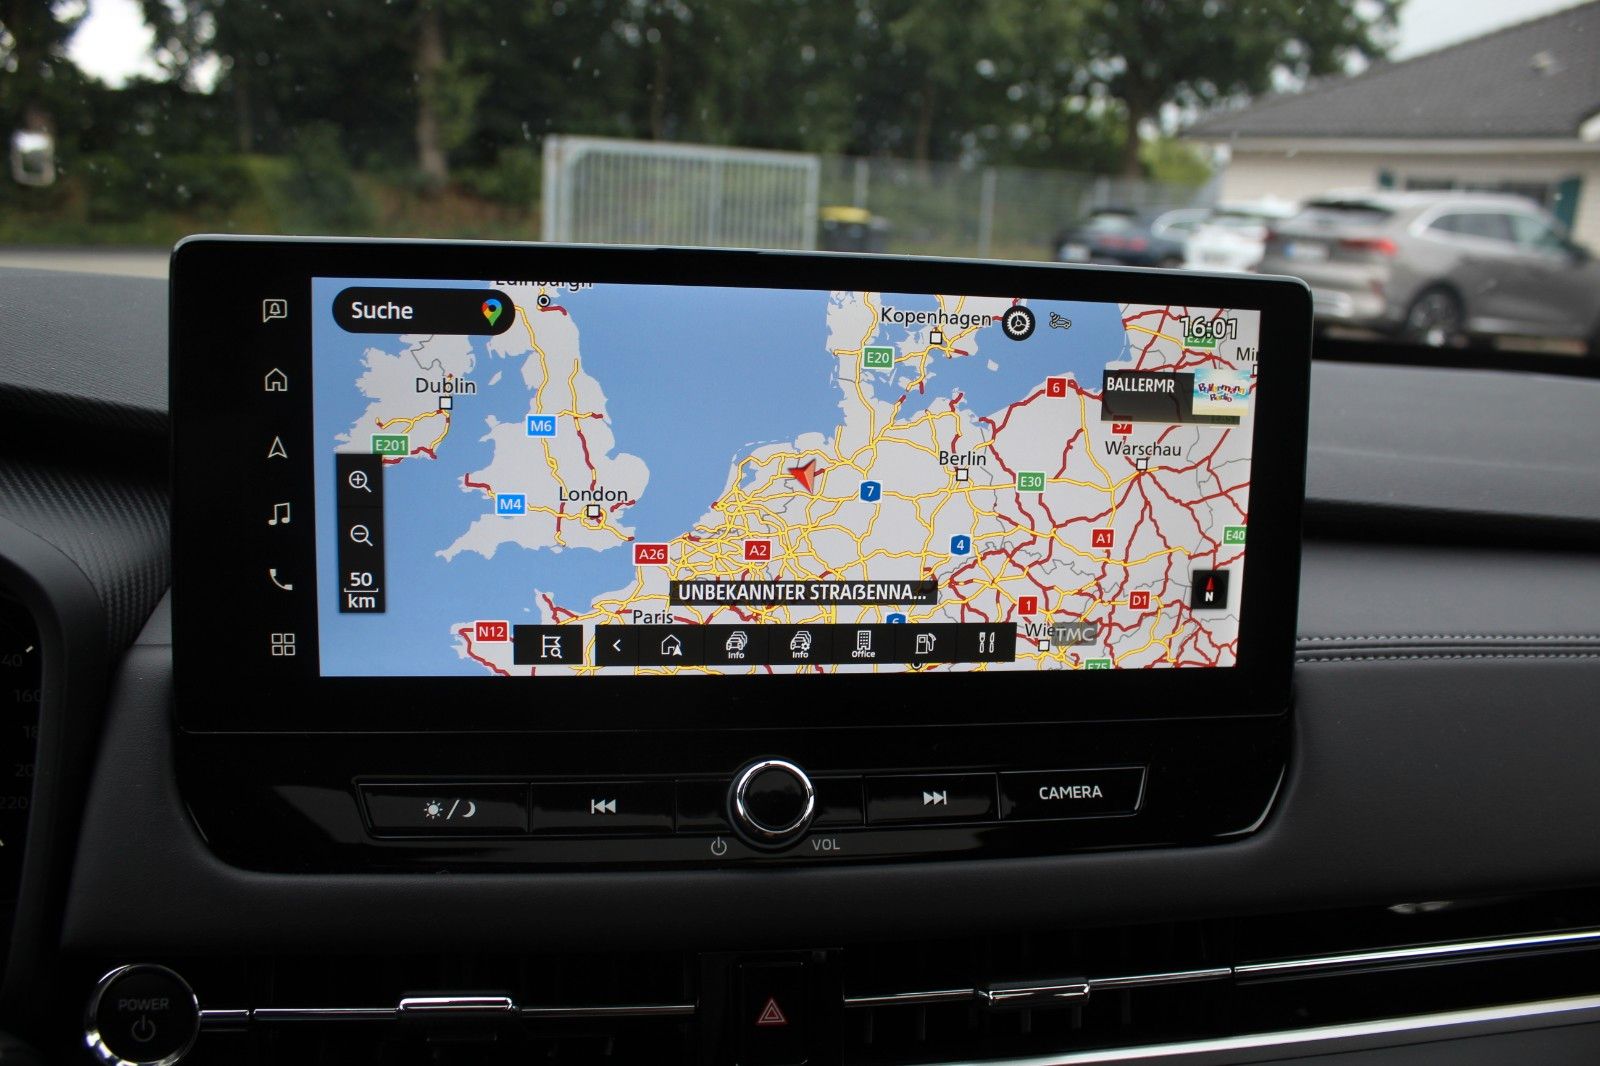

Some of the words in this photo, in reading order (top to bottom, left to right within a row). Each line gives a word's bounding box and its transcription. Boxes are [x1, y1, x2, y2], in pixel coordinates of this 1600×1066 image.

[351, 301, 413, 320] Suche
[881, 308, 992, 328] Kopenhagen
[1180, 316, 1238, 339] 16:01
[867, 352, 889, 364] E20
[415, 378, 476, 395] Dublin
[1052, 382, 1060, 393] 6
[1106, 377, 1175, 393] BALLERMR
[530, 420, 552, 433] M6
[375, 438, 406, 453] E201
[1105, 441, 1182, 457] Warschau
[938, 451, 987, 467] Berlin
[1020, 476, 1041, 488] E30
[559, 486, 628, 502] London
[866, 486, 875, 497] 7
[500, 498, 522, 511] M4
[1096, 533, 1111, 545] A1
[1225, 529, 1245, 541] E40
[749, 544, 767, 556] A2
[956, 539, 965, 551] 4
[639, 548, 665, 560] A26
[350, 572, 373, 587] 50
[678, 584, 805, 601] UNBEKANNTER
[810, 584, 927, 600] STRAßENNA...
[1205, 591, 1214, 602] N
[348, 593, 376, 608] km
[1025, 600, 1032, 611] 1
[1132, 595, 1147, 606] D1
[633, 610, 674, 625] Paris
[479, 626, 503, 638] N12
[1056, 627, 1096, 642] TMC
[728, 651, 745, 660] Info
[792, 651, 808, 659] Info
[851, 650, 876, 659] Office
[1039, 786, 1103, 800] CAMERA
[812, 839, 840, 851] VOL
[118, 998, 170, 1011] POWER
